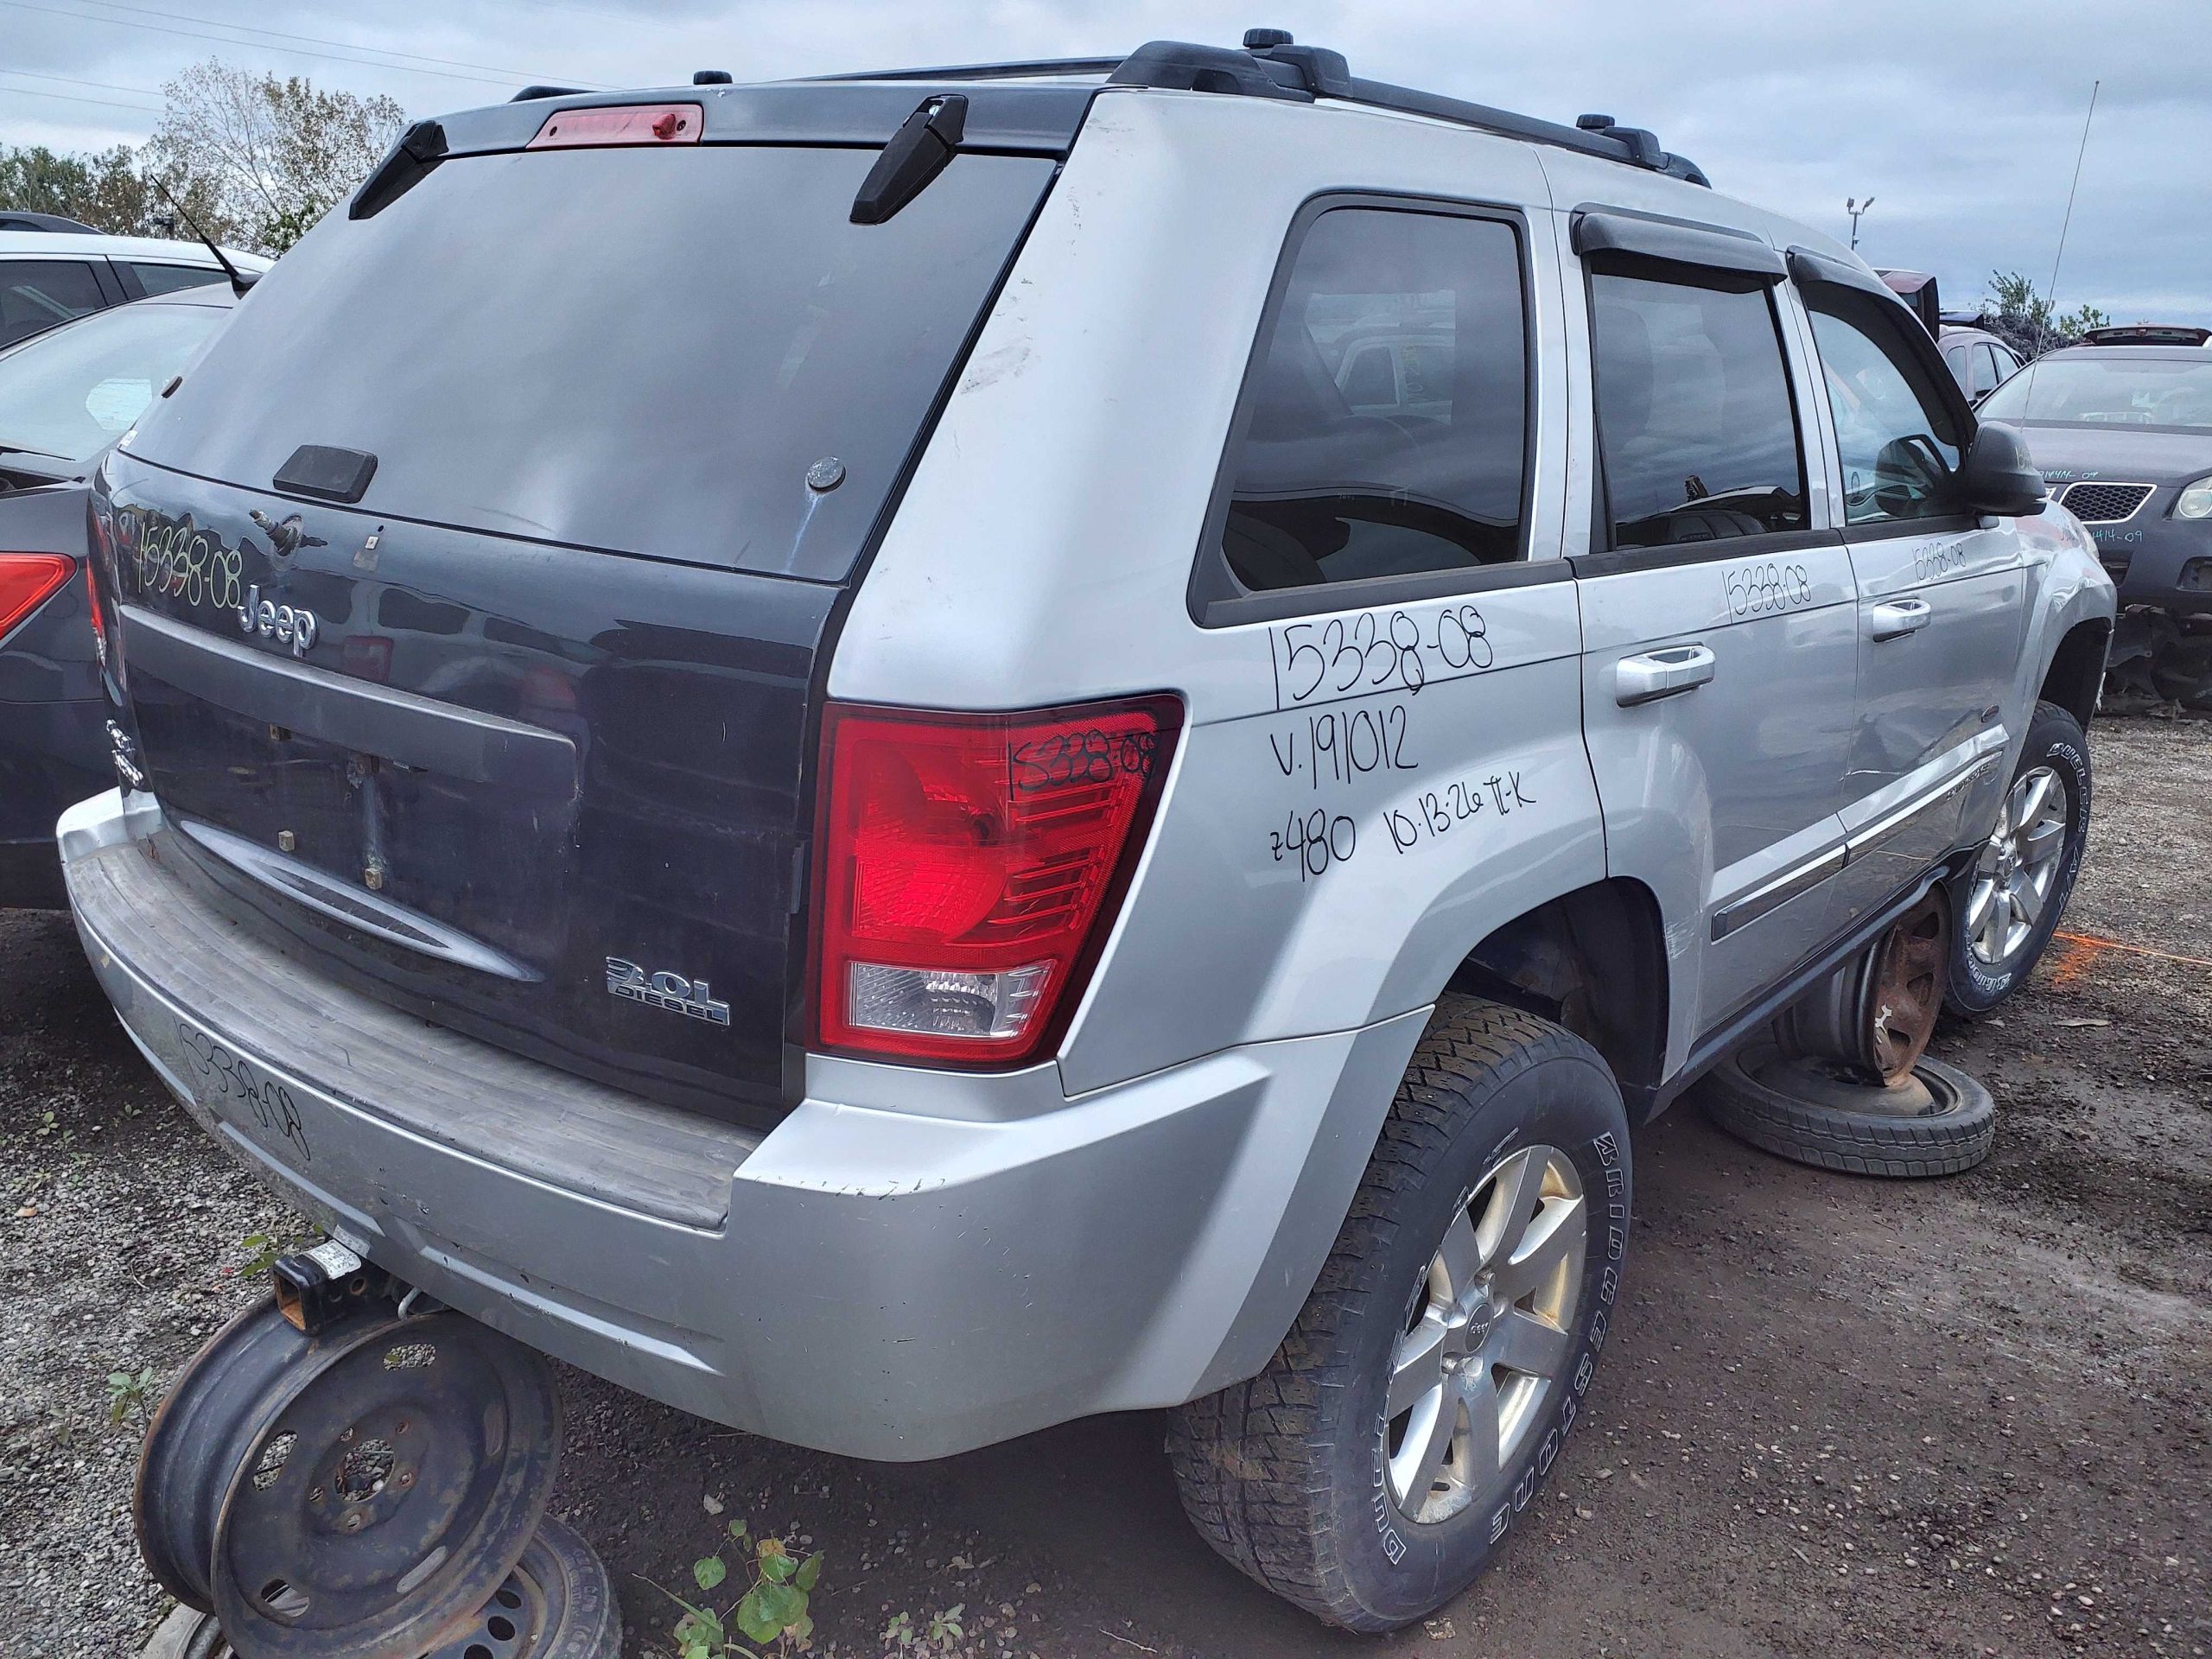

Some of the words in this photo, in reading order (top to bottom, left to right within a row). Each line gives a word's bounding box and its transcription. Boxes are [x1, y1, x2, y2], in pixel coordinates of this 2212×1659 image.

[138, 521, 244, 608] 15338-08
[238, 583, 321, 658] Jeep
[1268, 604, 1493, 711] 15338-08
[606, 956, 730, 1010] 3.0L
[613, 983, 727, 1026] DIESEL
[1489, 1130, 1625, 1545] BRIDGESTONE
